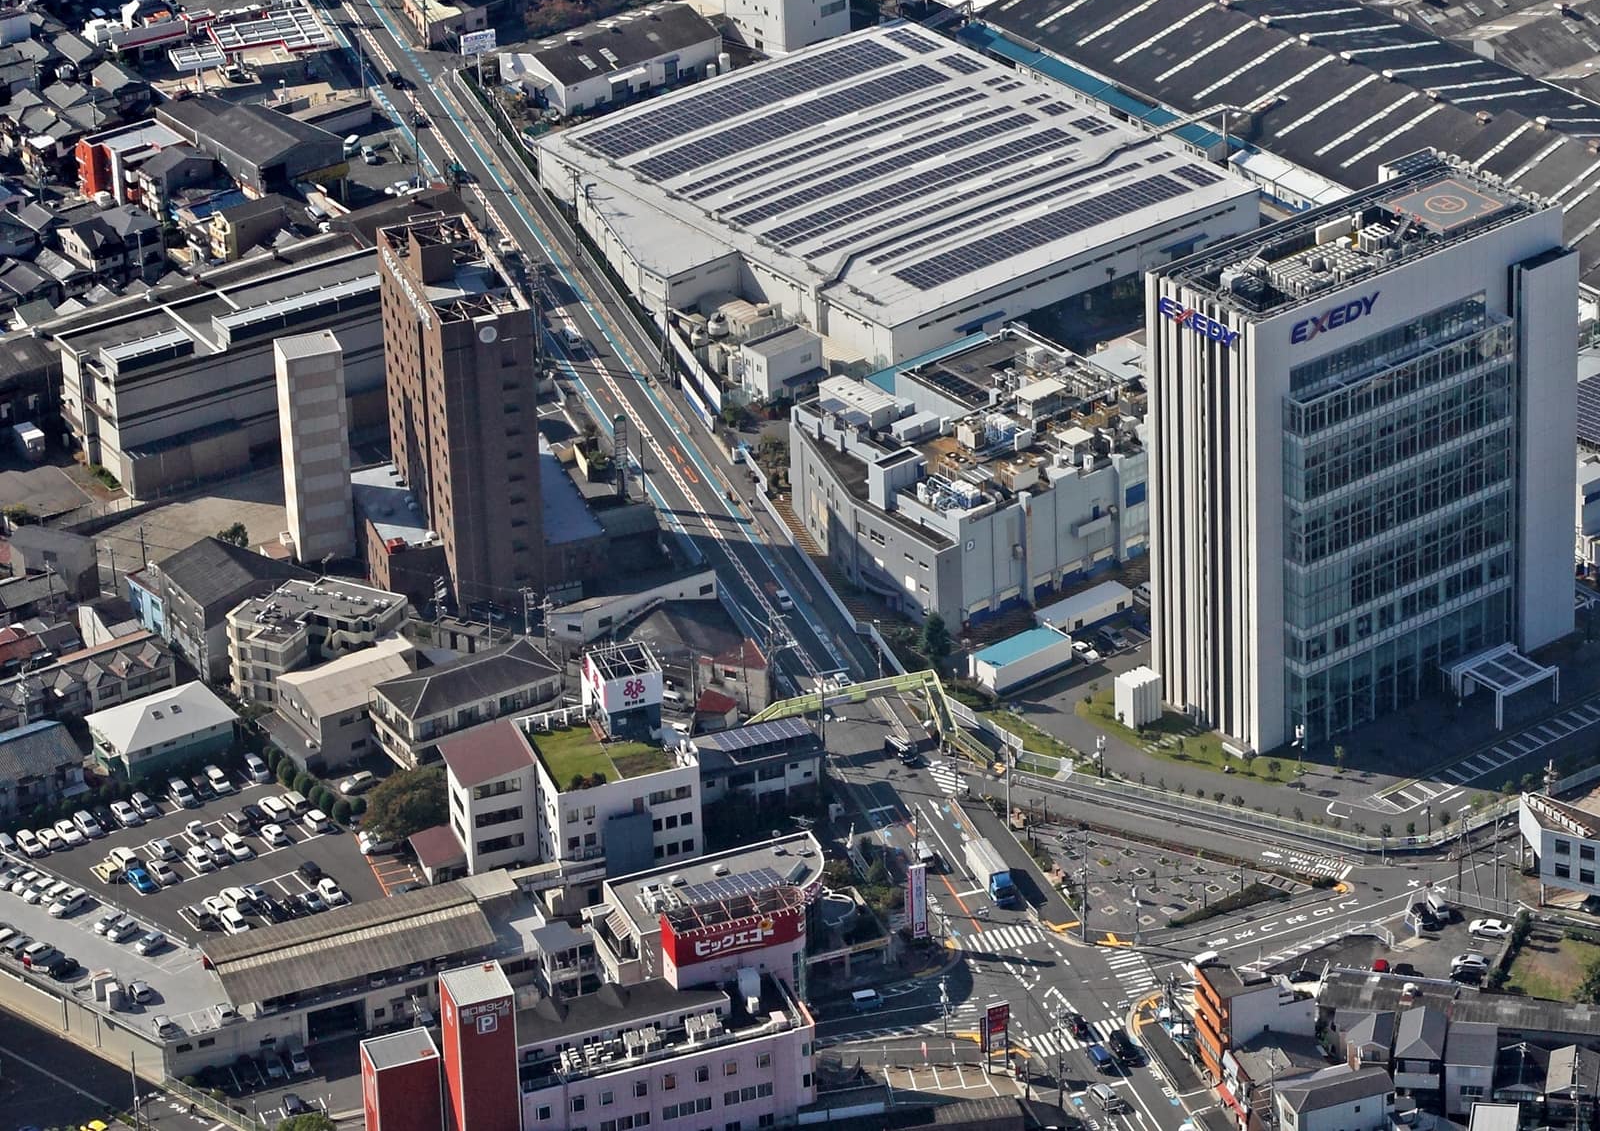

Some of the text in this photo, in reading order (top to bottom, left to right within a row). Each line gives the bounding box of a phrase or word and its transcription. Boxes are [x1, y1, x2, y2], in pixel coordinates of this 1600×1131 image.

[1159, 296, 1240, 348] EXEDY
[1290, 291, 1381, 345] EXEDY
[481, 1016, 494, 1031] P
